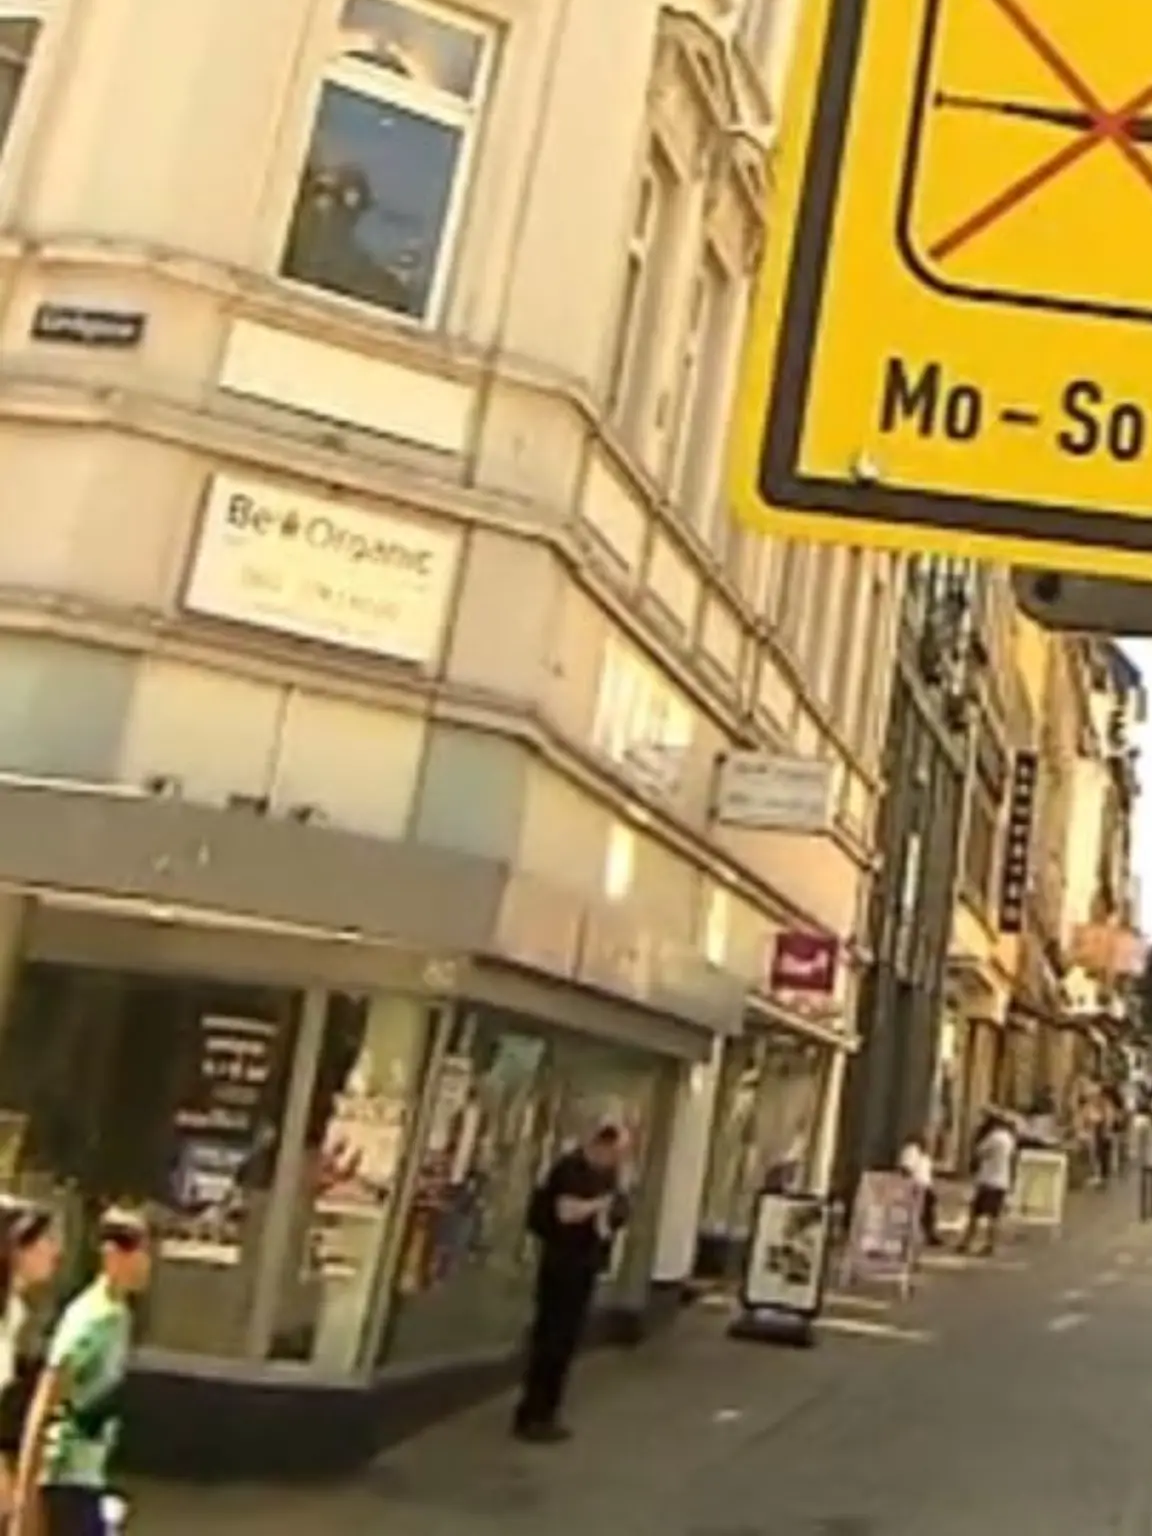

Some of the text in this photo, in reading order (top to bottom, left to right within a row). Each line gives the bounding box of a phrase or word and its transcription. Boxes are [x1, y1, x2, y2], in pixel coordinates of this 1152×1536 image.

[880, 357, 982, 441] Mo
[1058, 379, 1144, 462] So
[226, 492, 273, 536] Be
